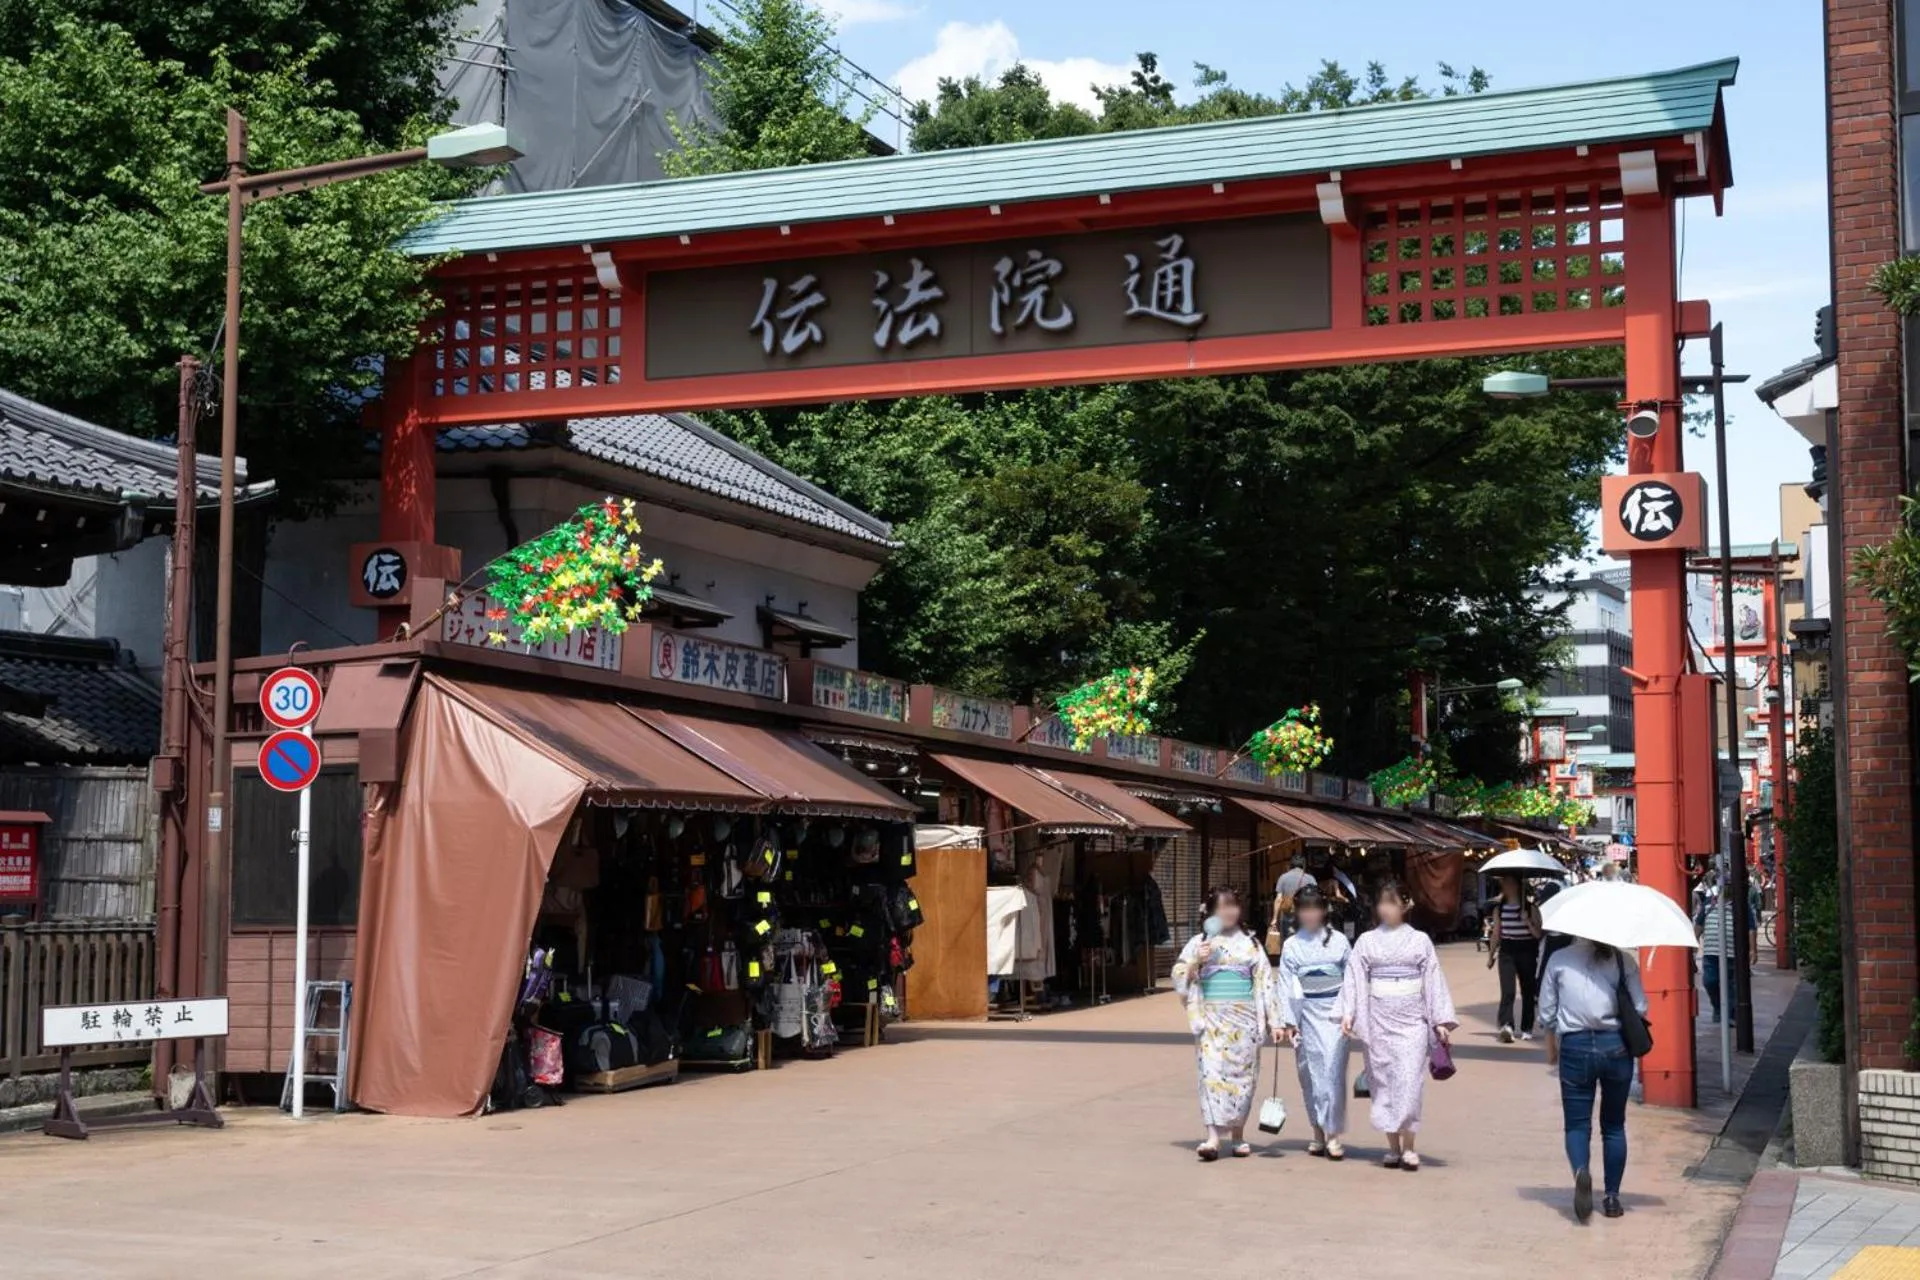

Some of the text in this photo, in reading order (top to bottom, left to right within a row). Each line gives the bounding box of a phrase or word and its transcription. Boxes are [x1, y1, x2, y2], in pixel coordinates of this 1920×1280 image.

[749, 234, 1208, 355] 伝法院通
[1622, 487, 1674, 534] 伝
[363, 553, 401, 592] 伝
[681, 639, 778, 697] 鈴木皮革店
[275, 686, 309, 711] 30
[81, 1005, 193, 1030] 駐輪禁止
